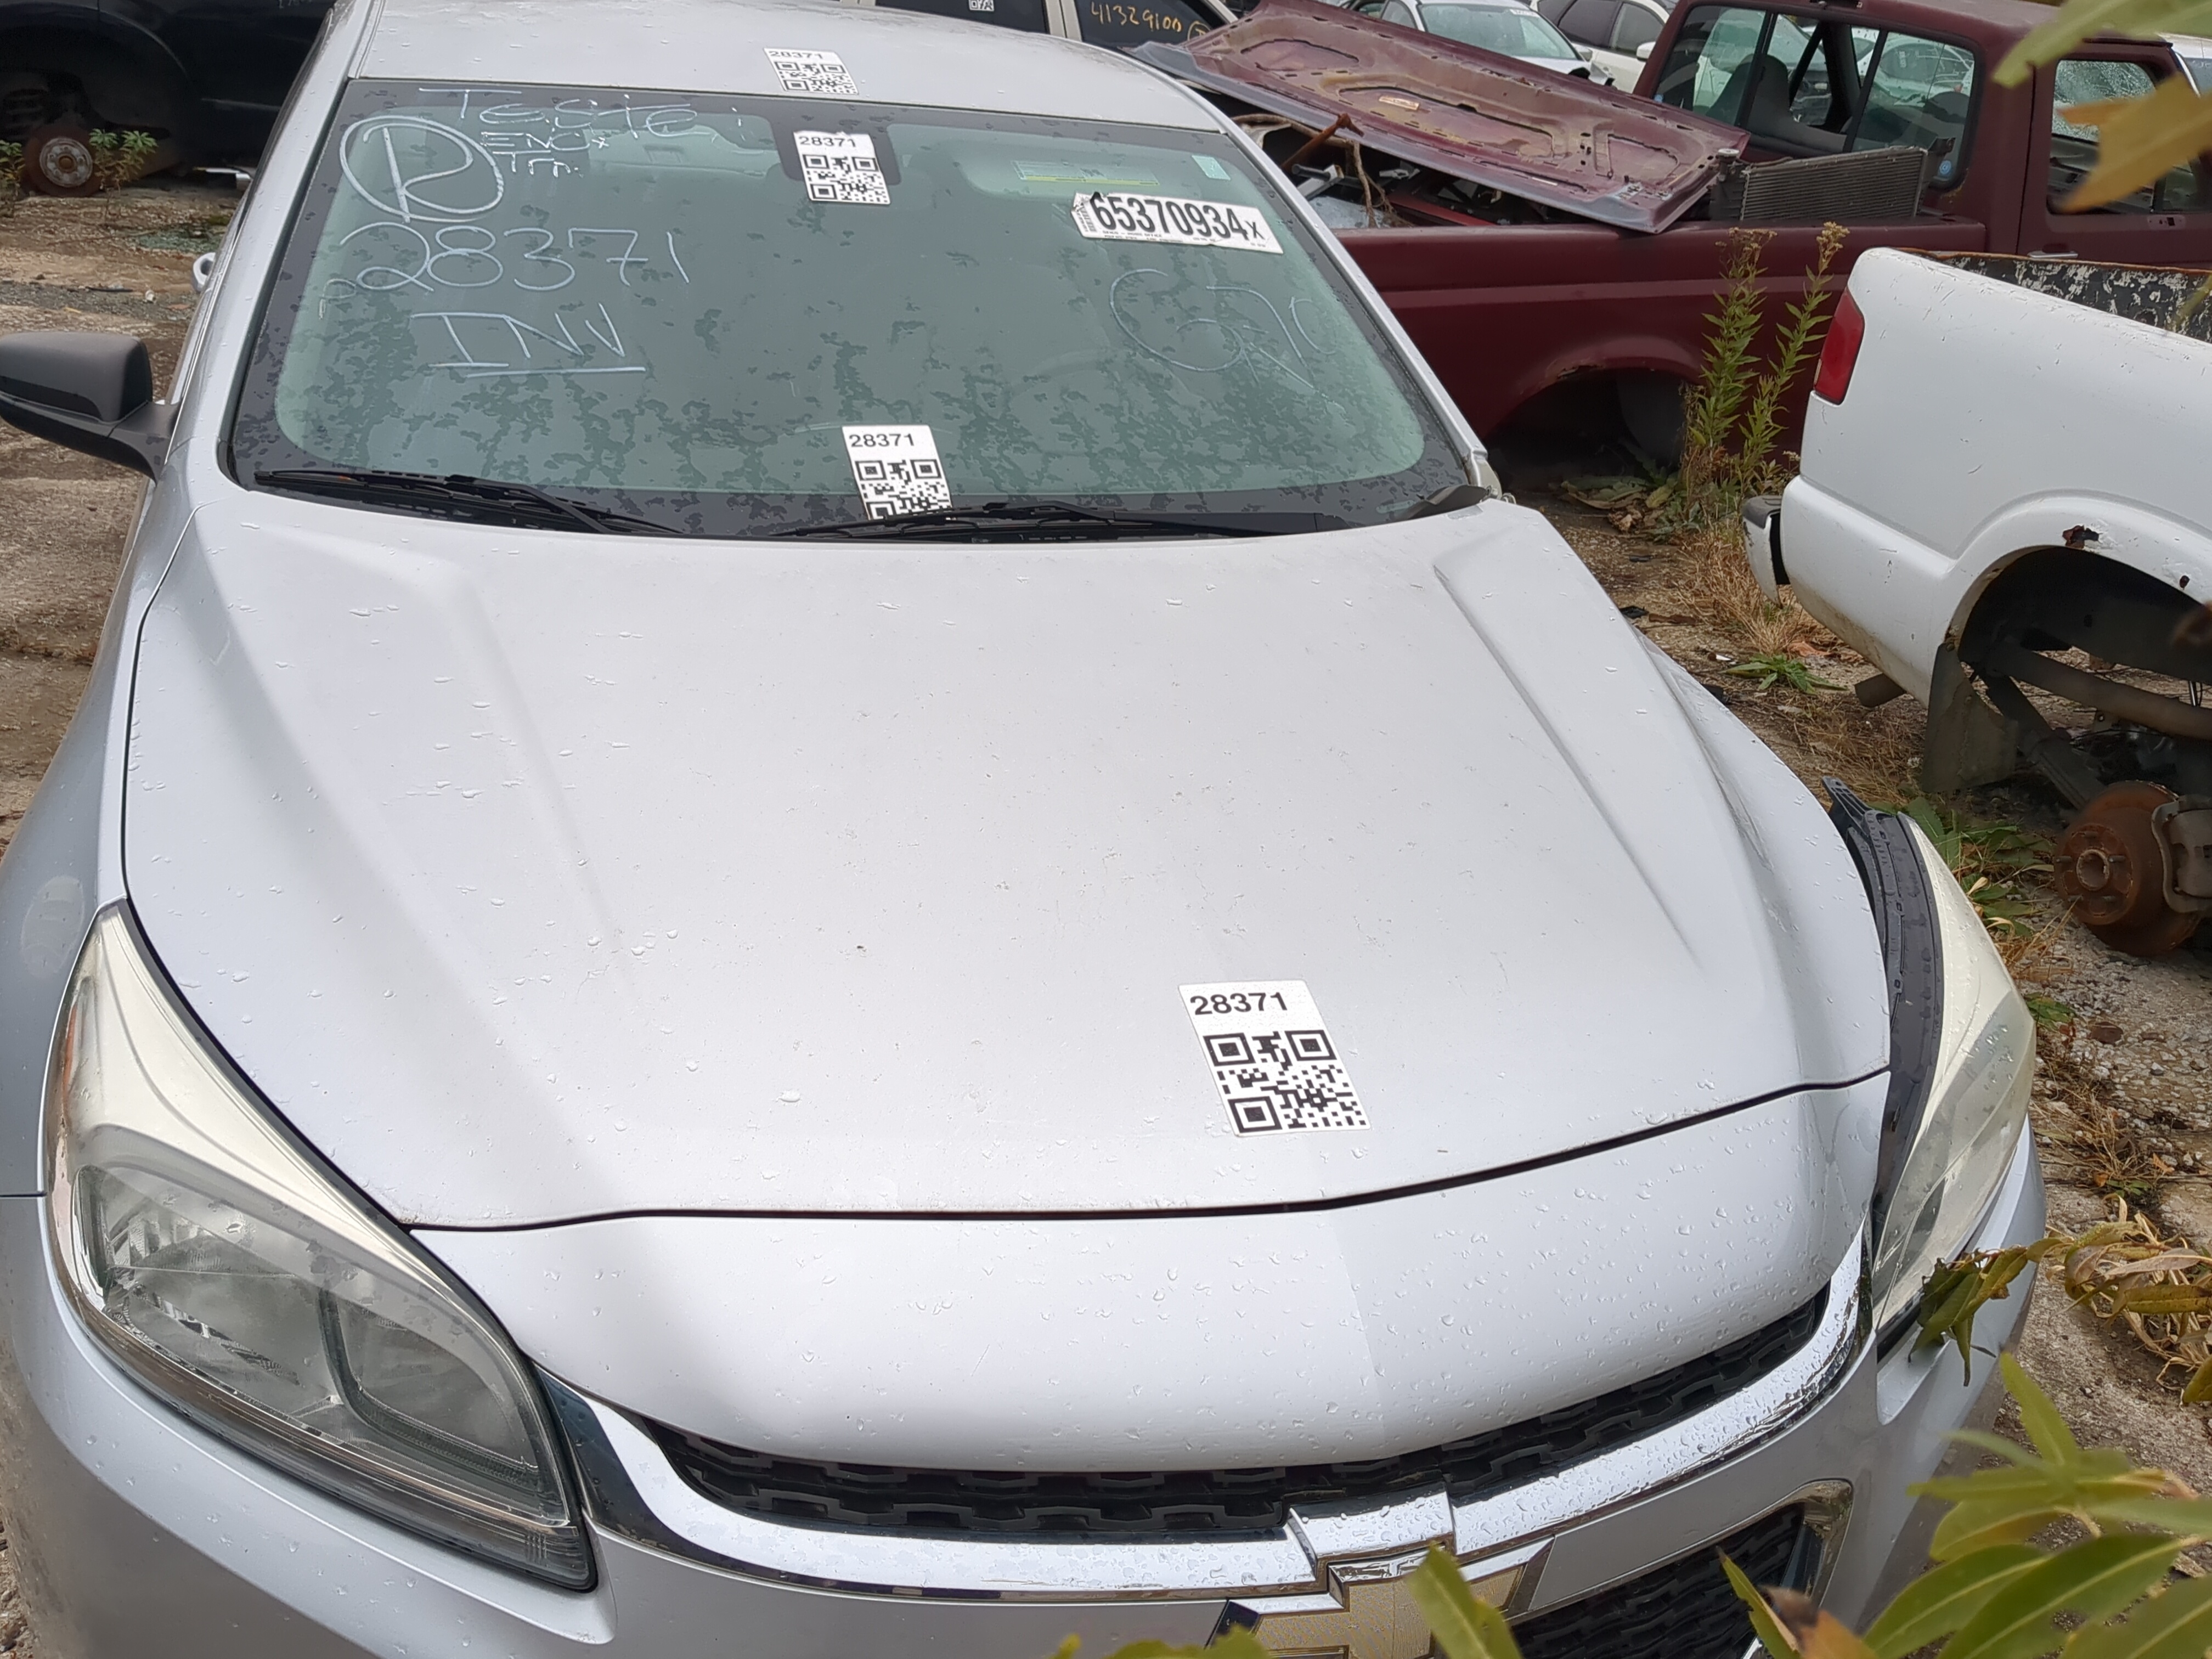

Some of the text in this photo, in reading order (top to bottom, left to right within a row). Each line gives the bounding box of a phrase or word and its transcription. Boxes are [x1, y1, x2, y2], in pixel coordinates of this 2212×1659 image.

[1091, 1, 1182, 32] 41329100
[769, 50, 823, 59] 28371
[799, 136, 856, 148] 28371
[340, 221, 690, 292] 28371
[409, 302, 628, 368] INV
[849, 433, 915, 448] 28371
[1189, 992, 1288, 1015] 28371
